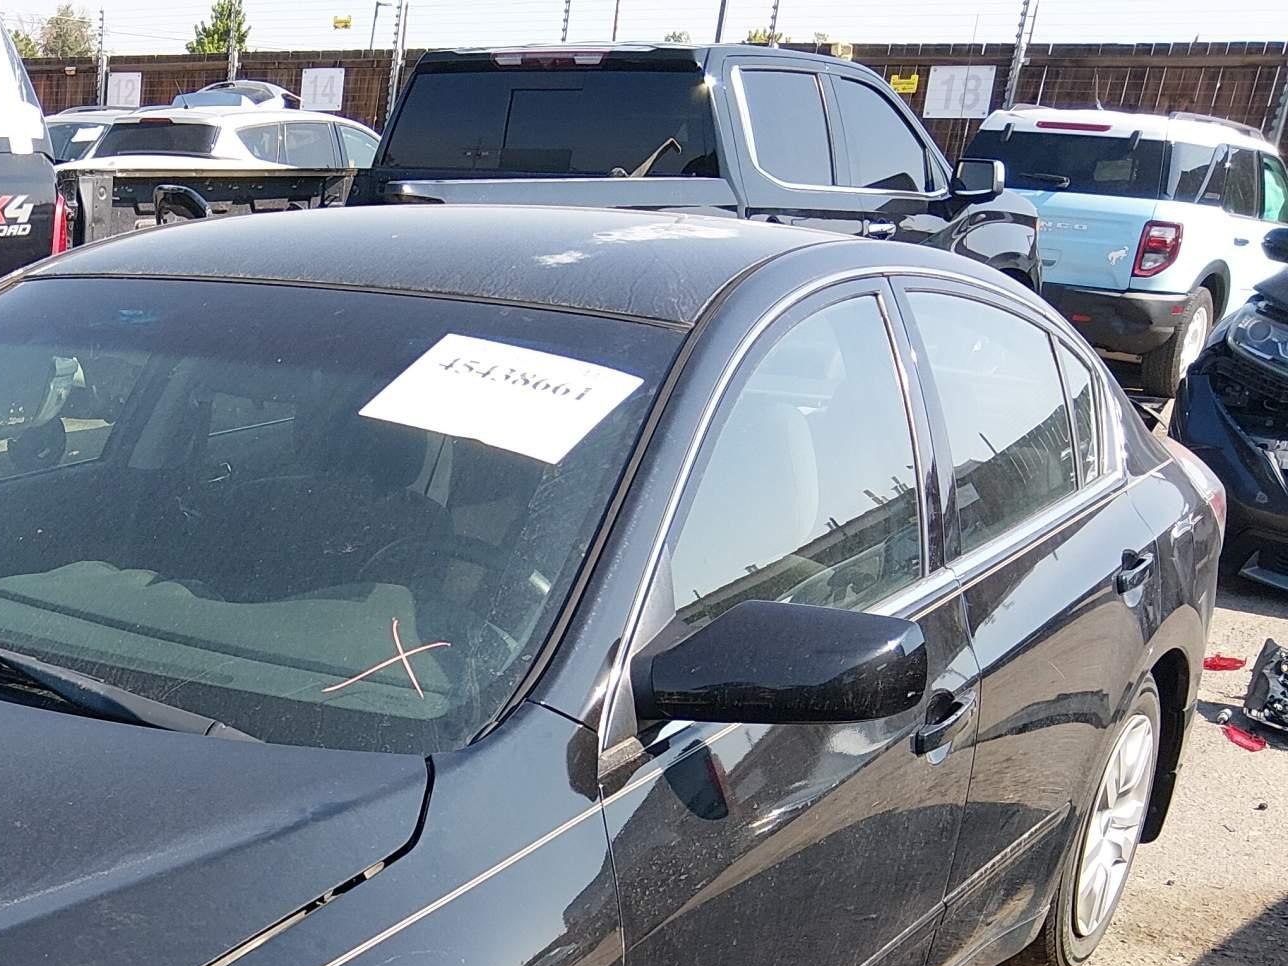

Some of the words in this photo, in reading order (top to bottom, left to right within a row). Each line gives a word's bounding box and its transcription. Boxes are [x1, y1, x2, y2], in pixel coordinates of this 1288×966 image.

[113, 79, 136, 105] 12
[309, 75, 336, 104] 14
[941, 74, 982, 111] 18
[439, 357, 593, 401] 45438661
